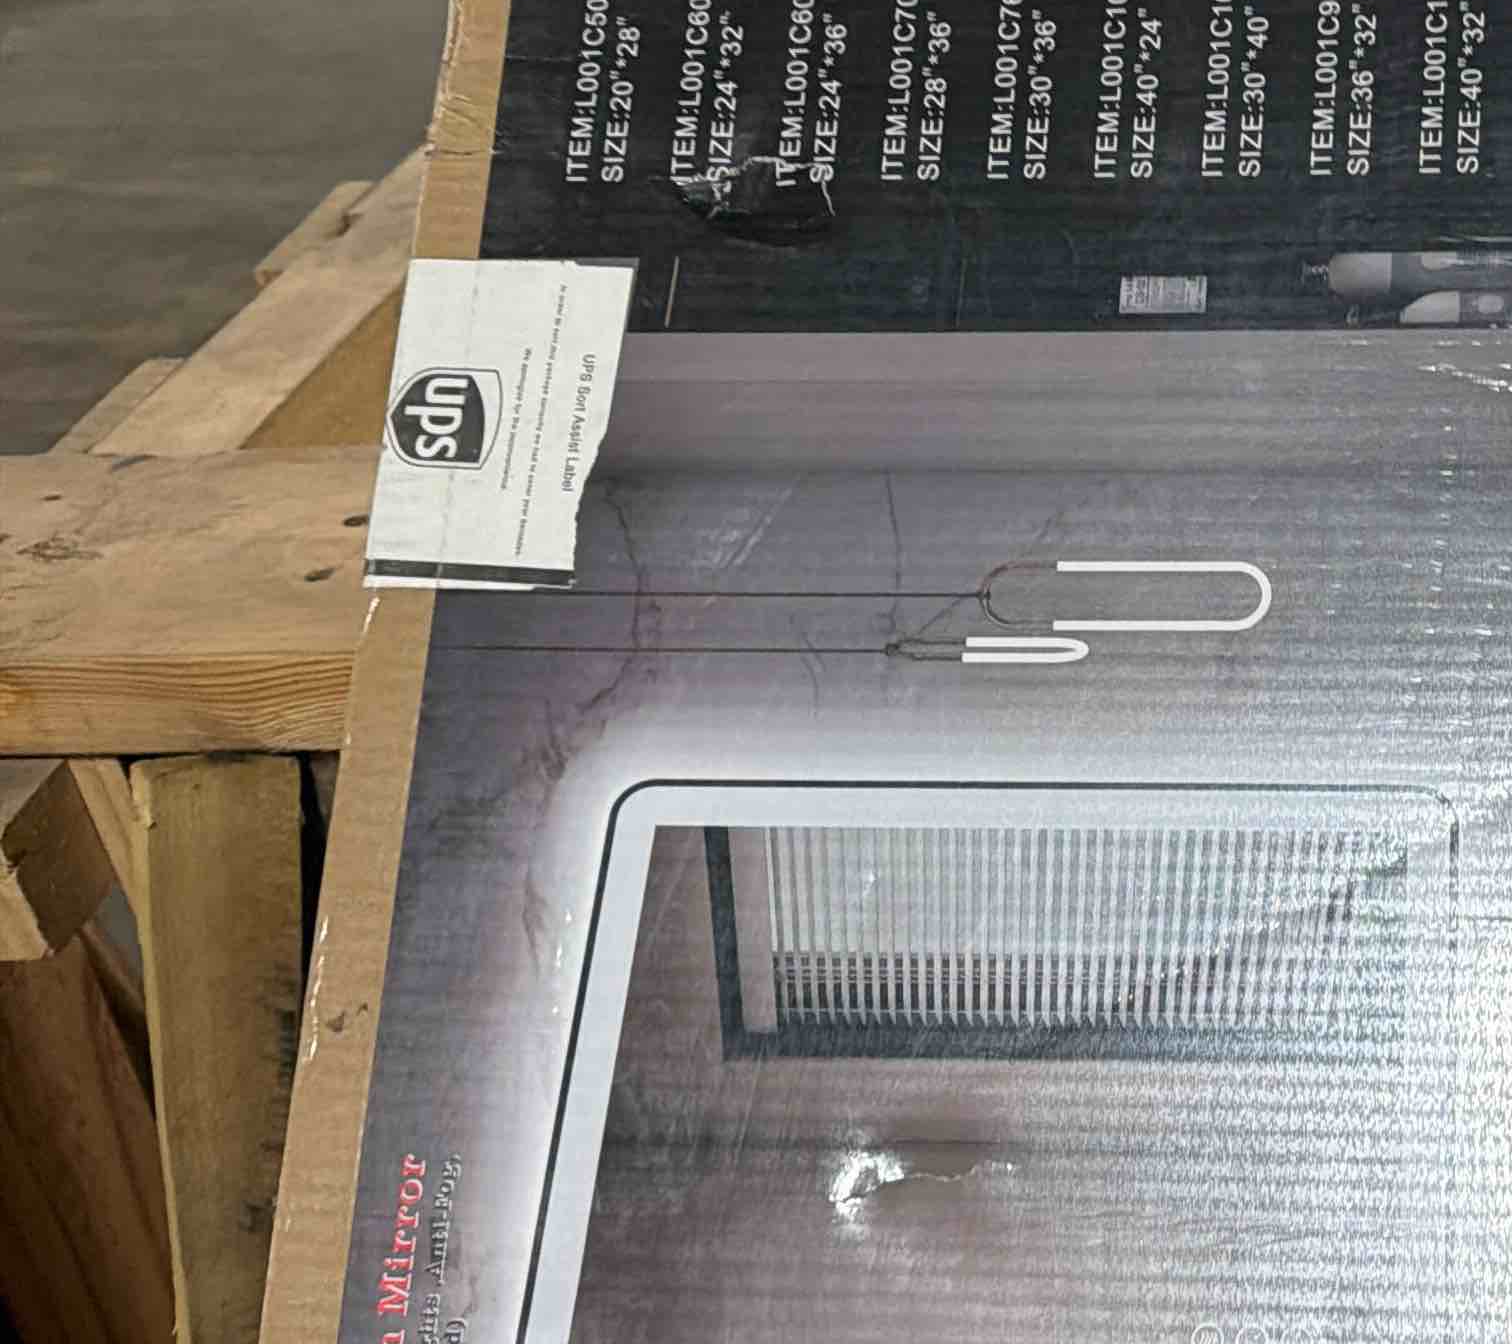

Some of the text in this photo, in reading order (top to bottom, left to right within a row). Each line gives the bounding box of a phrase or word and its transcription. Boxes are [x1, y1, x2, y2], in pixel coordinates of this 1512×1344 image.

[404, 376, 470, 459] ups
[561, 456, 581, 492] Label
[376, 1152, 428, 1318] Mirror
